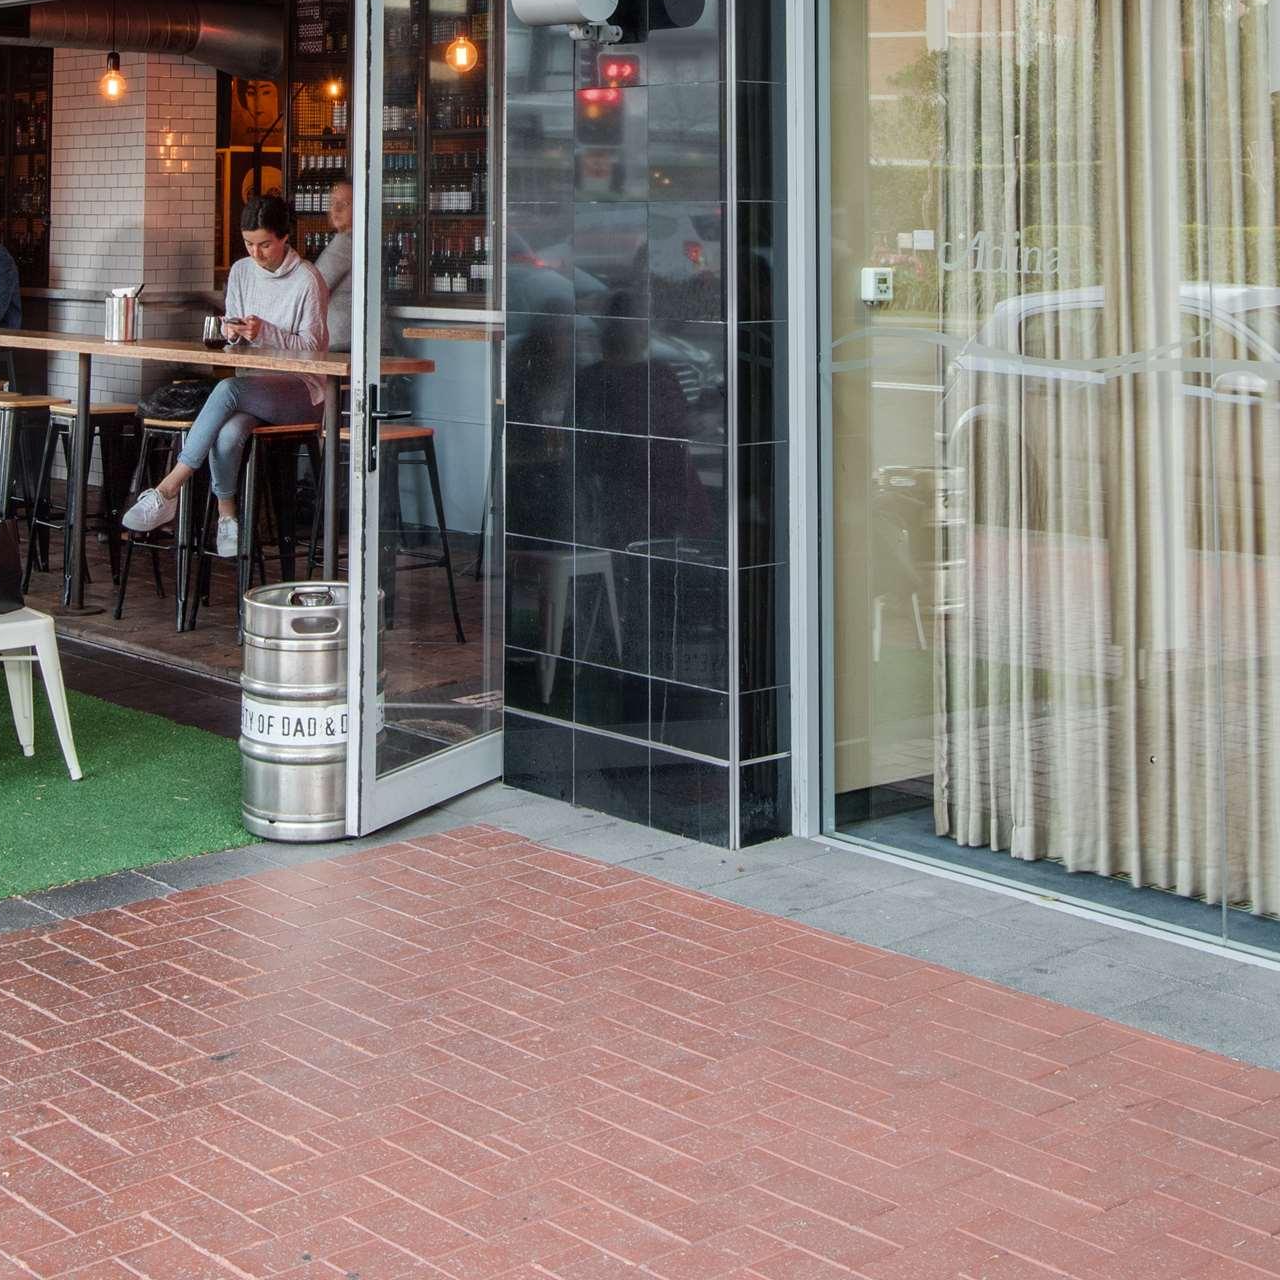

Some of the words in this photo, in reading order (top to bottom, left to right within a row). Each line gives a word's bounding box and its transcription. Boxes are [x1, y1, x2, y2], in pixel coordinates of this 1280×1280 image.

[938, 230, 1064, 274] Adina
[257, 714, 275, 736] OF
[281, 716, 317, 737] DAD
[325, 717, 336, 737] &
